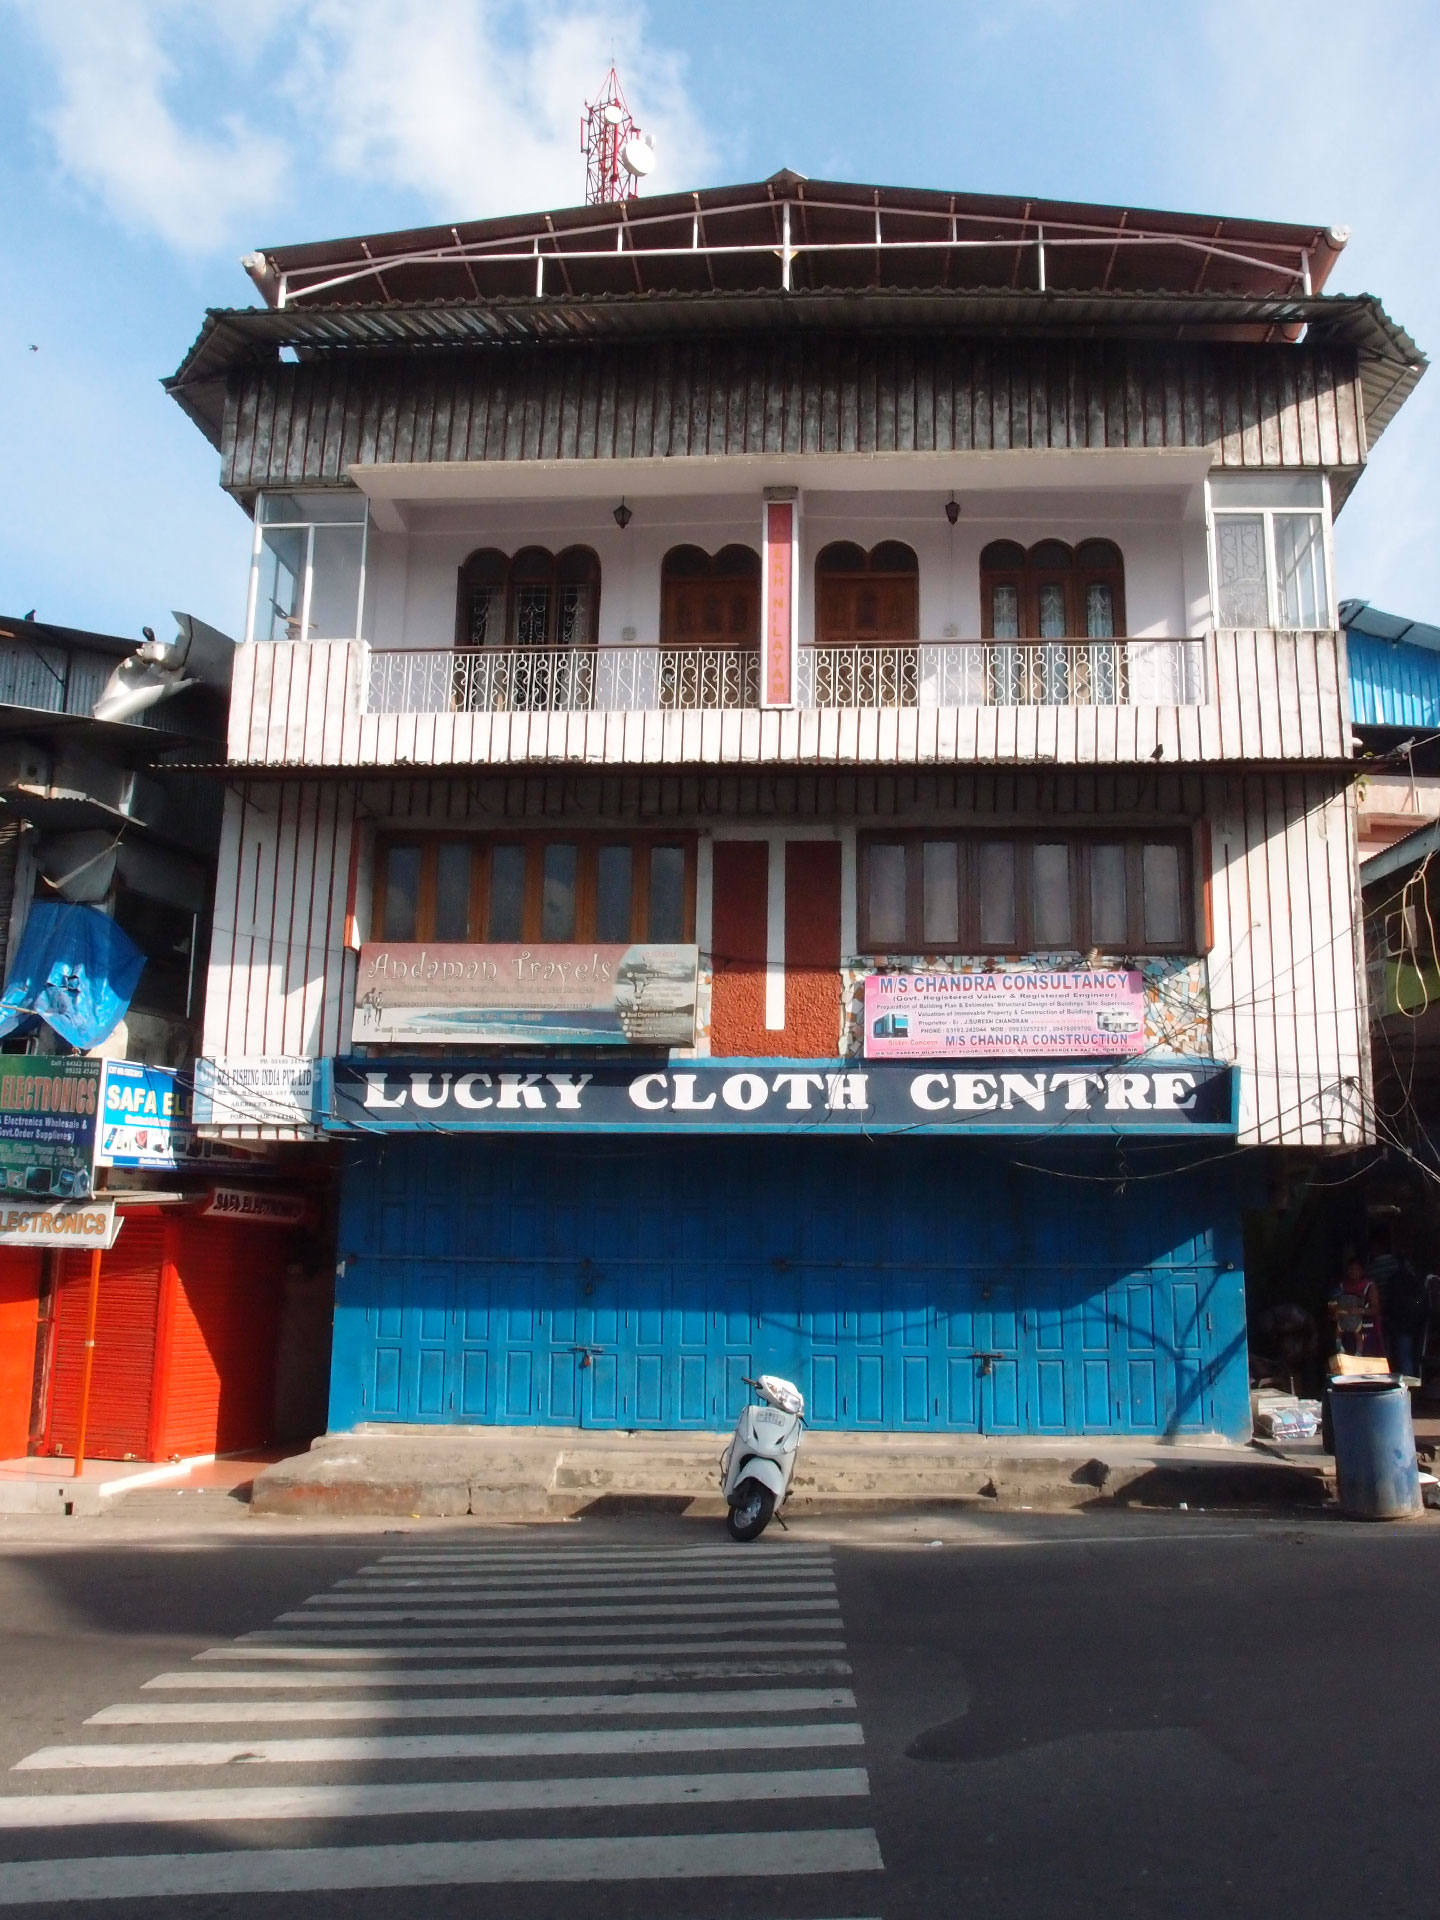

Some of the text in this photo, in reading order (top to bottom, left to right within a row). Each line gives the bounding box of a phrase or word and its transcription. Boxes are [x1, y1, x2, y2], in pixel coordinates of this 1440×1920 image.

[772, 598, 784, 694] NILAYAM
[368, 951, 612, 989] Andaman Travels
[880, 974, 1128, 994] M/S CHANDRA CONSULTANCY
[946, 1036, 966, 1046] M/S
[970, 1034, 1028, 1046] CHANDRA
[1032, 1034, 1128, 1045] CONSTRUCTION
[218, 1069, 230, 1086] SEA
[232, 1069, 259, 1086] FISHING
[262, 1069, 280, 1086] INDIA
[298, 1069, 312, 1086] LTD
[364, 1072, 1198, 1111] LUCKY CLOTH CENTRE
[0, 1075, 97, 1115] ELECTRONICS
[106, 1084, 158, 1115] SAFA
[4, 1115, 43, 1127] Electronics
[44, 1118, 80, 1129] Wholesale
[82, 1120, 88, 1130] &
